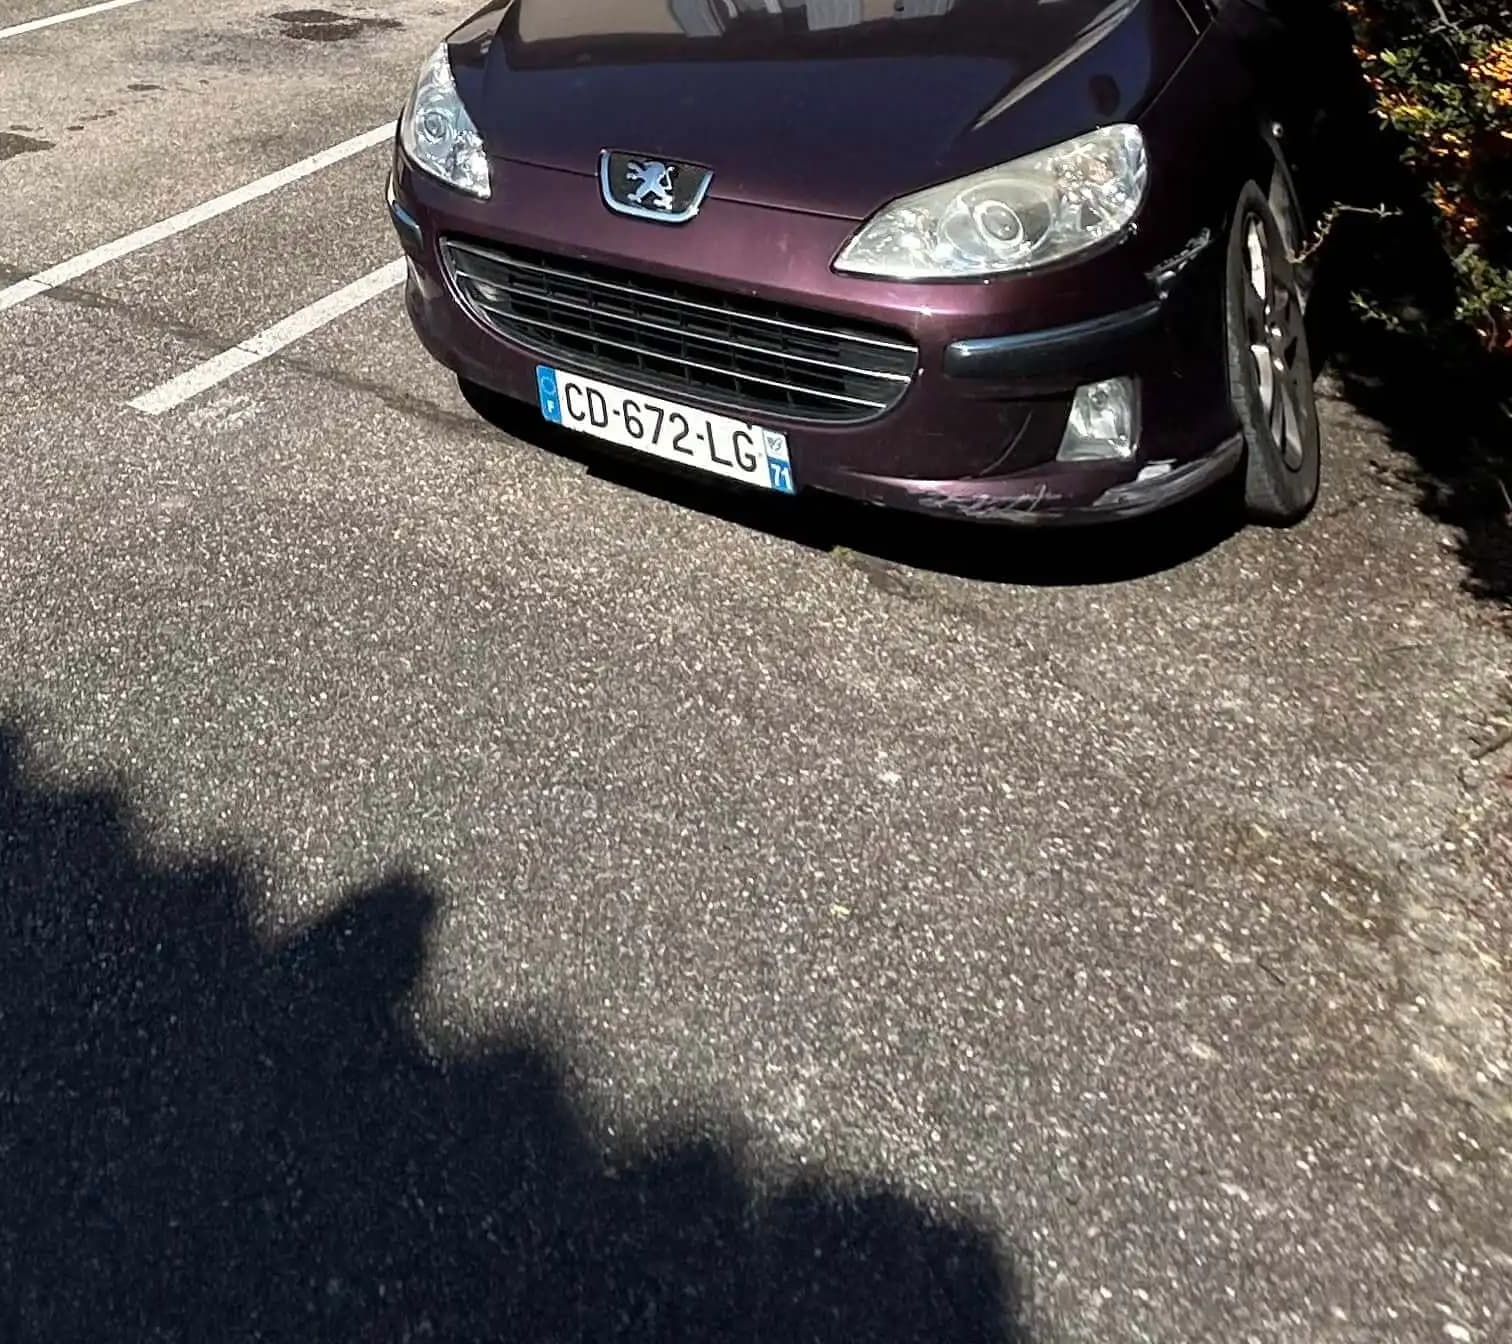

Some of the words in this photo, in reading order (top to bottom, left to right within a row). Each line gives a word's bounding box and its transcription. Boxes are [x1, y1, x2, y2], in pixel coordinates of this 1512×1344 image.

[546, 399, 555, 413] F
[564, 382, 758, 473] CD-672-LG
[770, 463, 793, 490] 71
